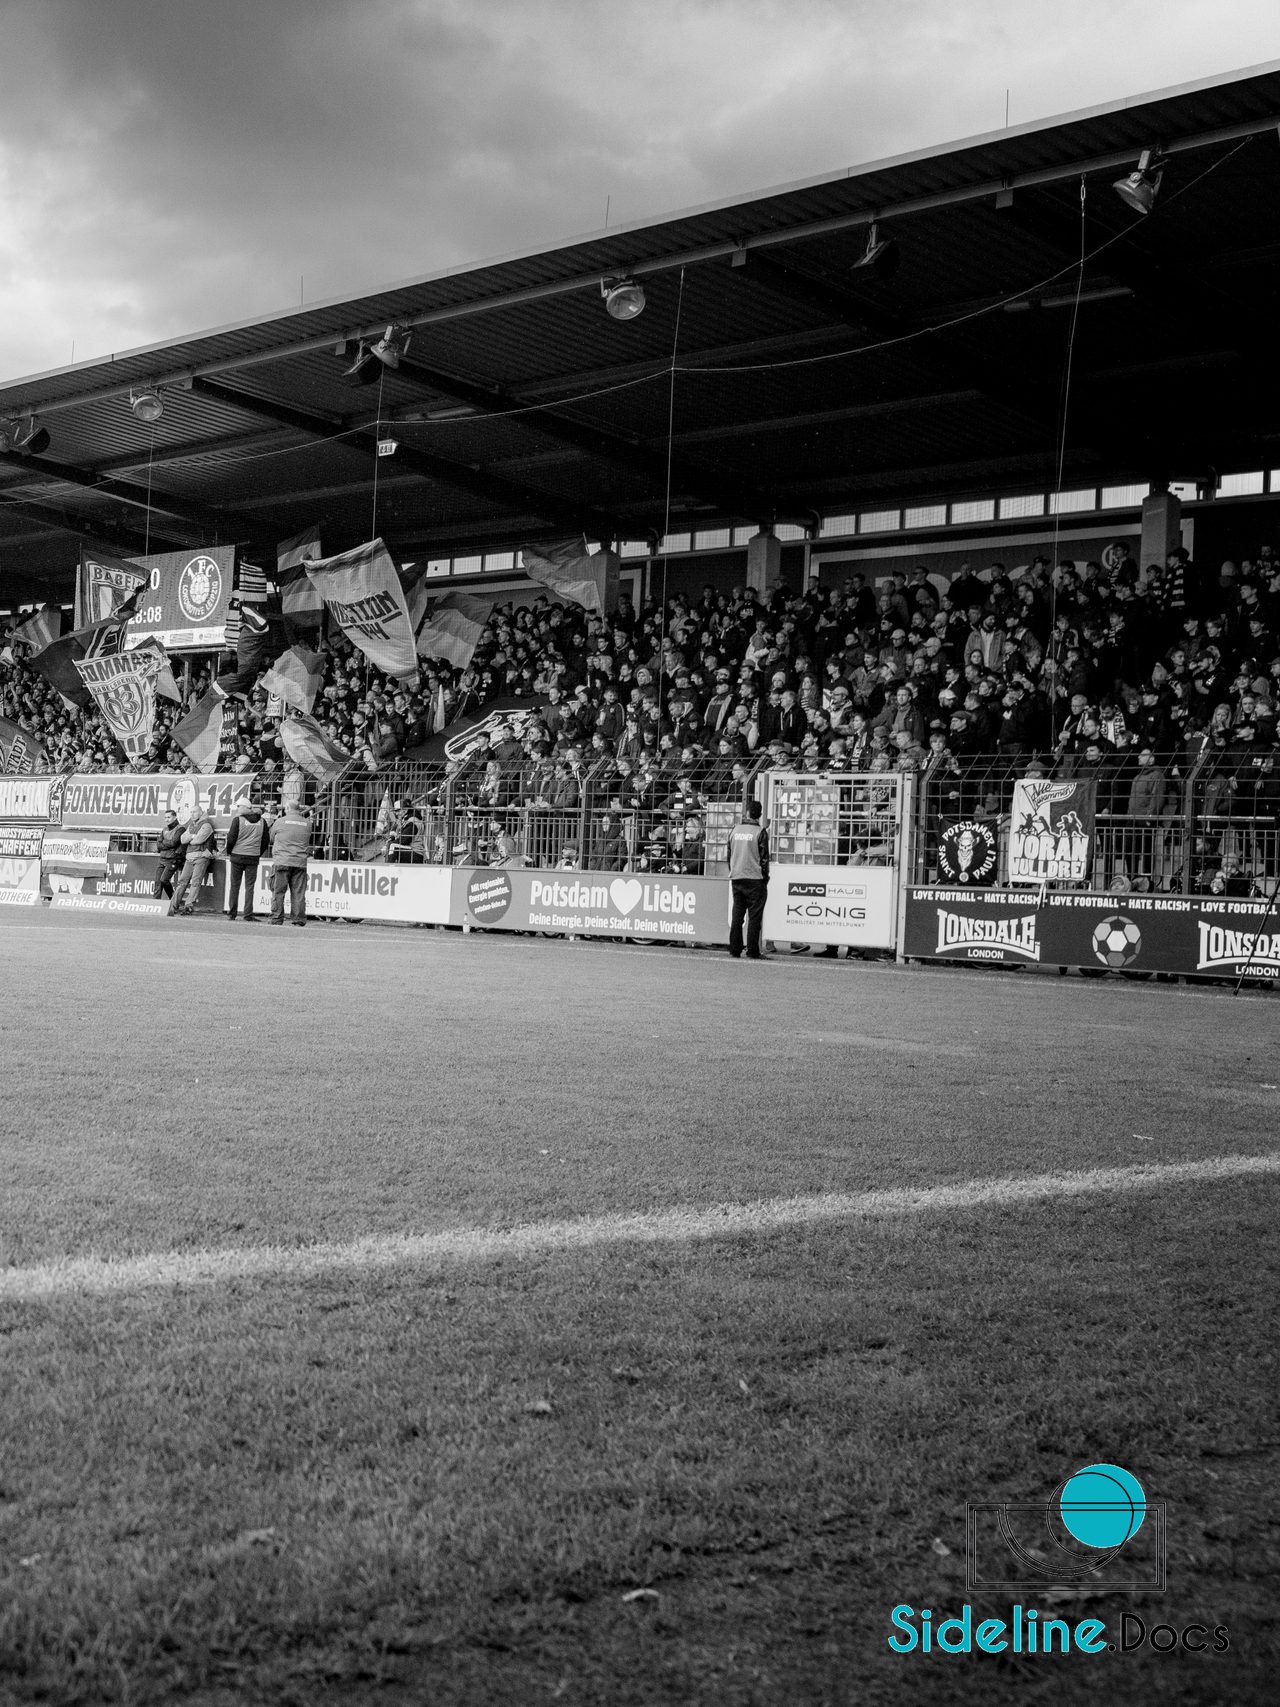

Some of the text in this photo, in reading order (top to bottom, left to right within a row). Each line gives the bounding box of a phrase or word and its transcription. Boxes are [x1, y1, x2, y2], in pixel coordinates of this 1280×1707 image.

[150, 568, 161, 590] 0
[92, 676, 137, 694] BABELSBERG
[64, 784, 160, 815] CONNECTION
[778, 793, 801, 817] 15
[942, 821, 995, 847] POTSDAMER
[1014, 833, 1089, 862] VORAN
[113, 860, 127, 874] wir
[938, 845, 955, 878] SANKT
[972, 850, 997, 880] PAULI
[119, 879, 132, 893] ins
[530, 880, 696, 914] Potsdam Liebe
[57, 897, 162, 913] nahkauf Oelmann
[787, 901, 866, 920] KÖNIG
[913, 890, 1277, 915] LOVE FOOTBALL HATE RACISM LOVE FOOTBALL HATE RACISM LOVE FOOTBALL
[529, 913, 696, 935] Deine Energie. Deine Stadt. Deine Vorteile.
[936, 908, 1038, 955] LONSDALE
[968, 949, 1004, 959] LONDON
